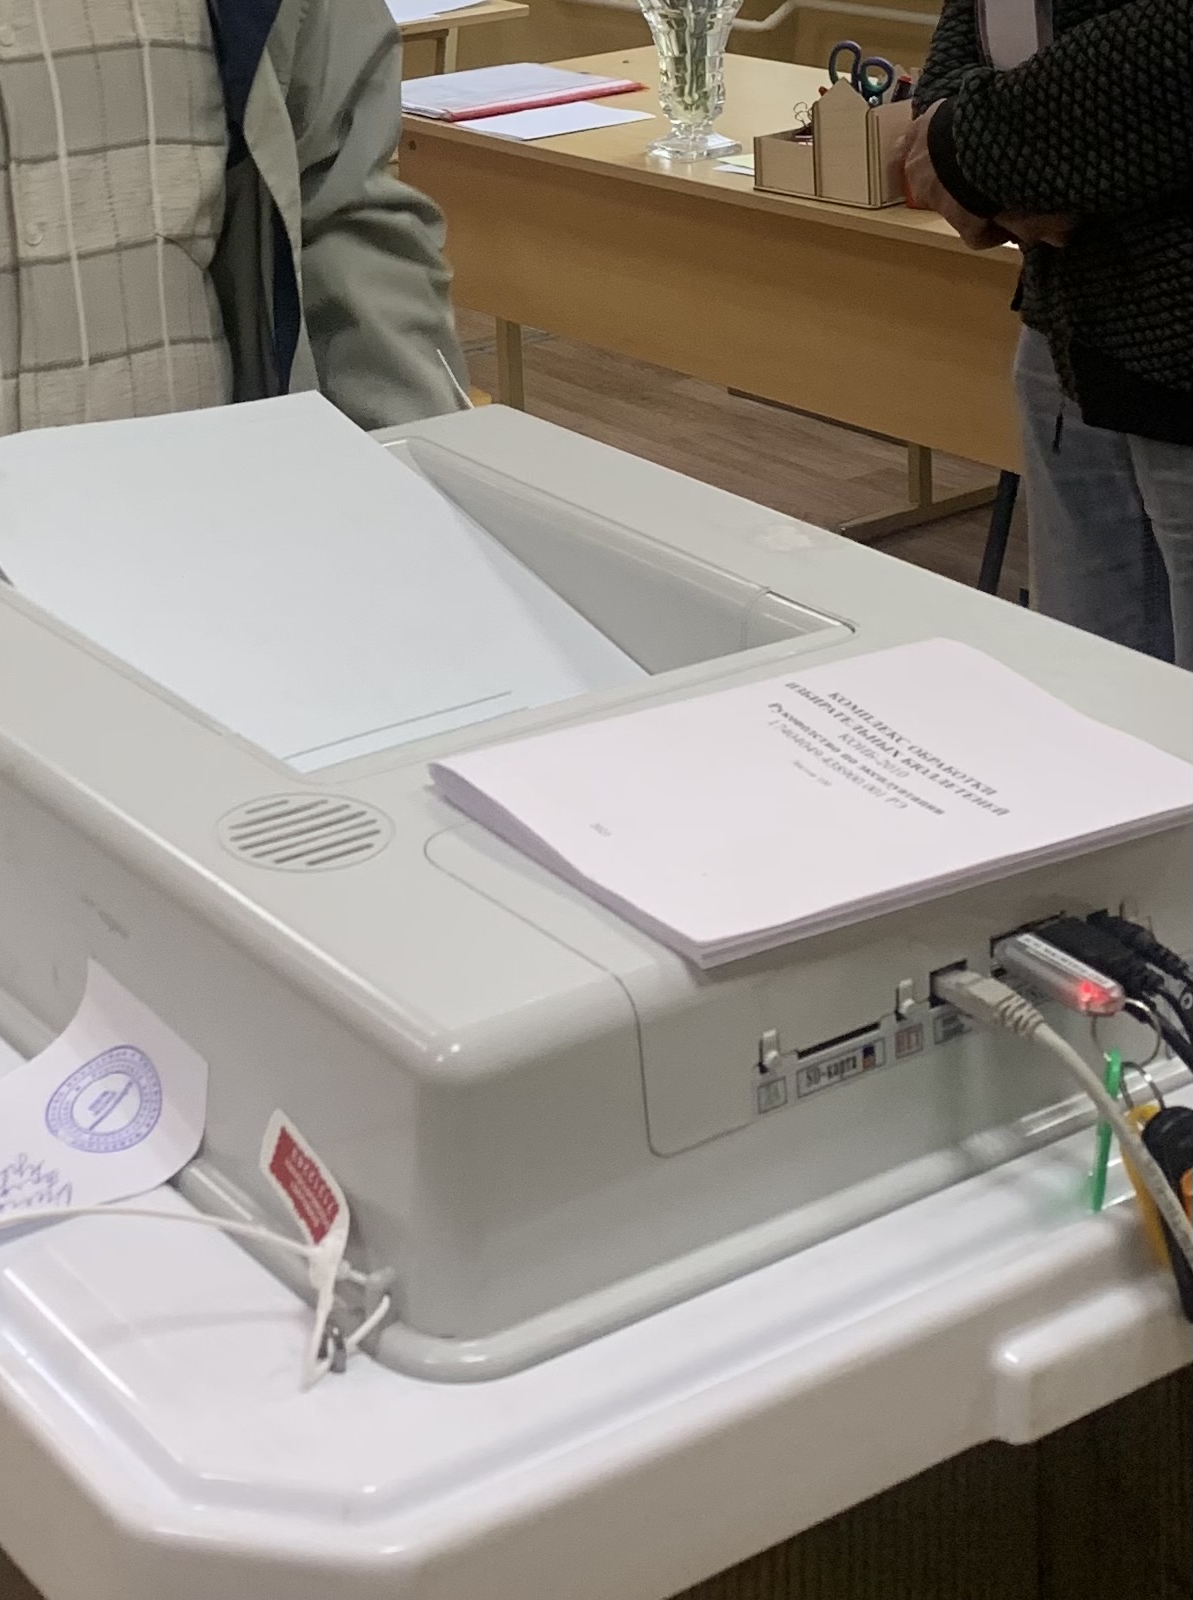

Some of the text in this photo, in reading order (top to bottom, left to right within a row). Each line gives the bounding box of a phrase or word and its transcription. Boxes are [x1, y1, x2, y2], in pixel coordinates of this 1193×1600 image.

[768, 702, 841, 754] Руководство
[840, 752, 858, 765] по
[858, 764, 946, 815] эксплуатации
[784, 681, 900, 759] ИЗБИРАТЕЛЬНЫХ
[901, 757, 1011, 817] БЮЛЛЕТЕНЕЙ
[827, 691, 998, 796] КОМПЛЕКС ОБРАБОТКИ
[804, 1054, 858, 1088] SD-карта
